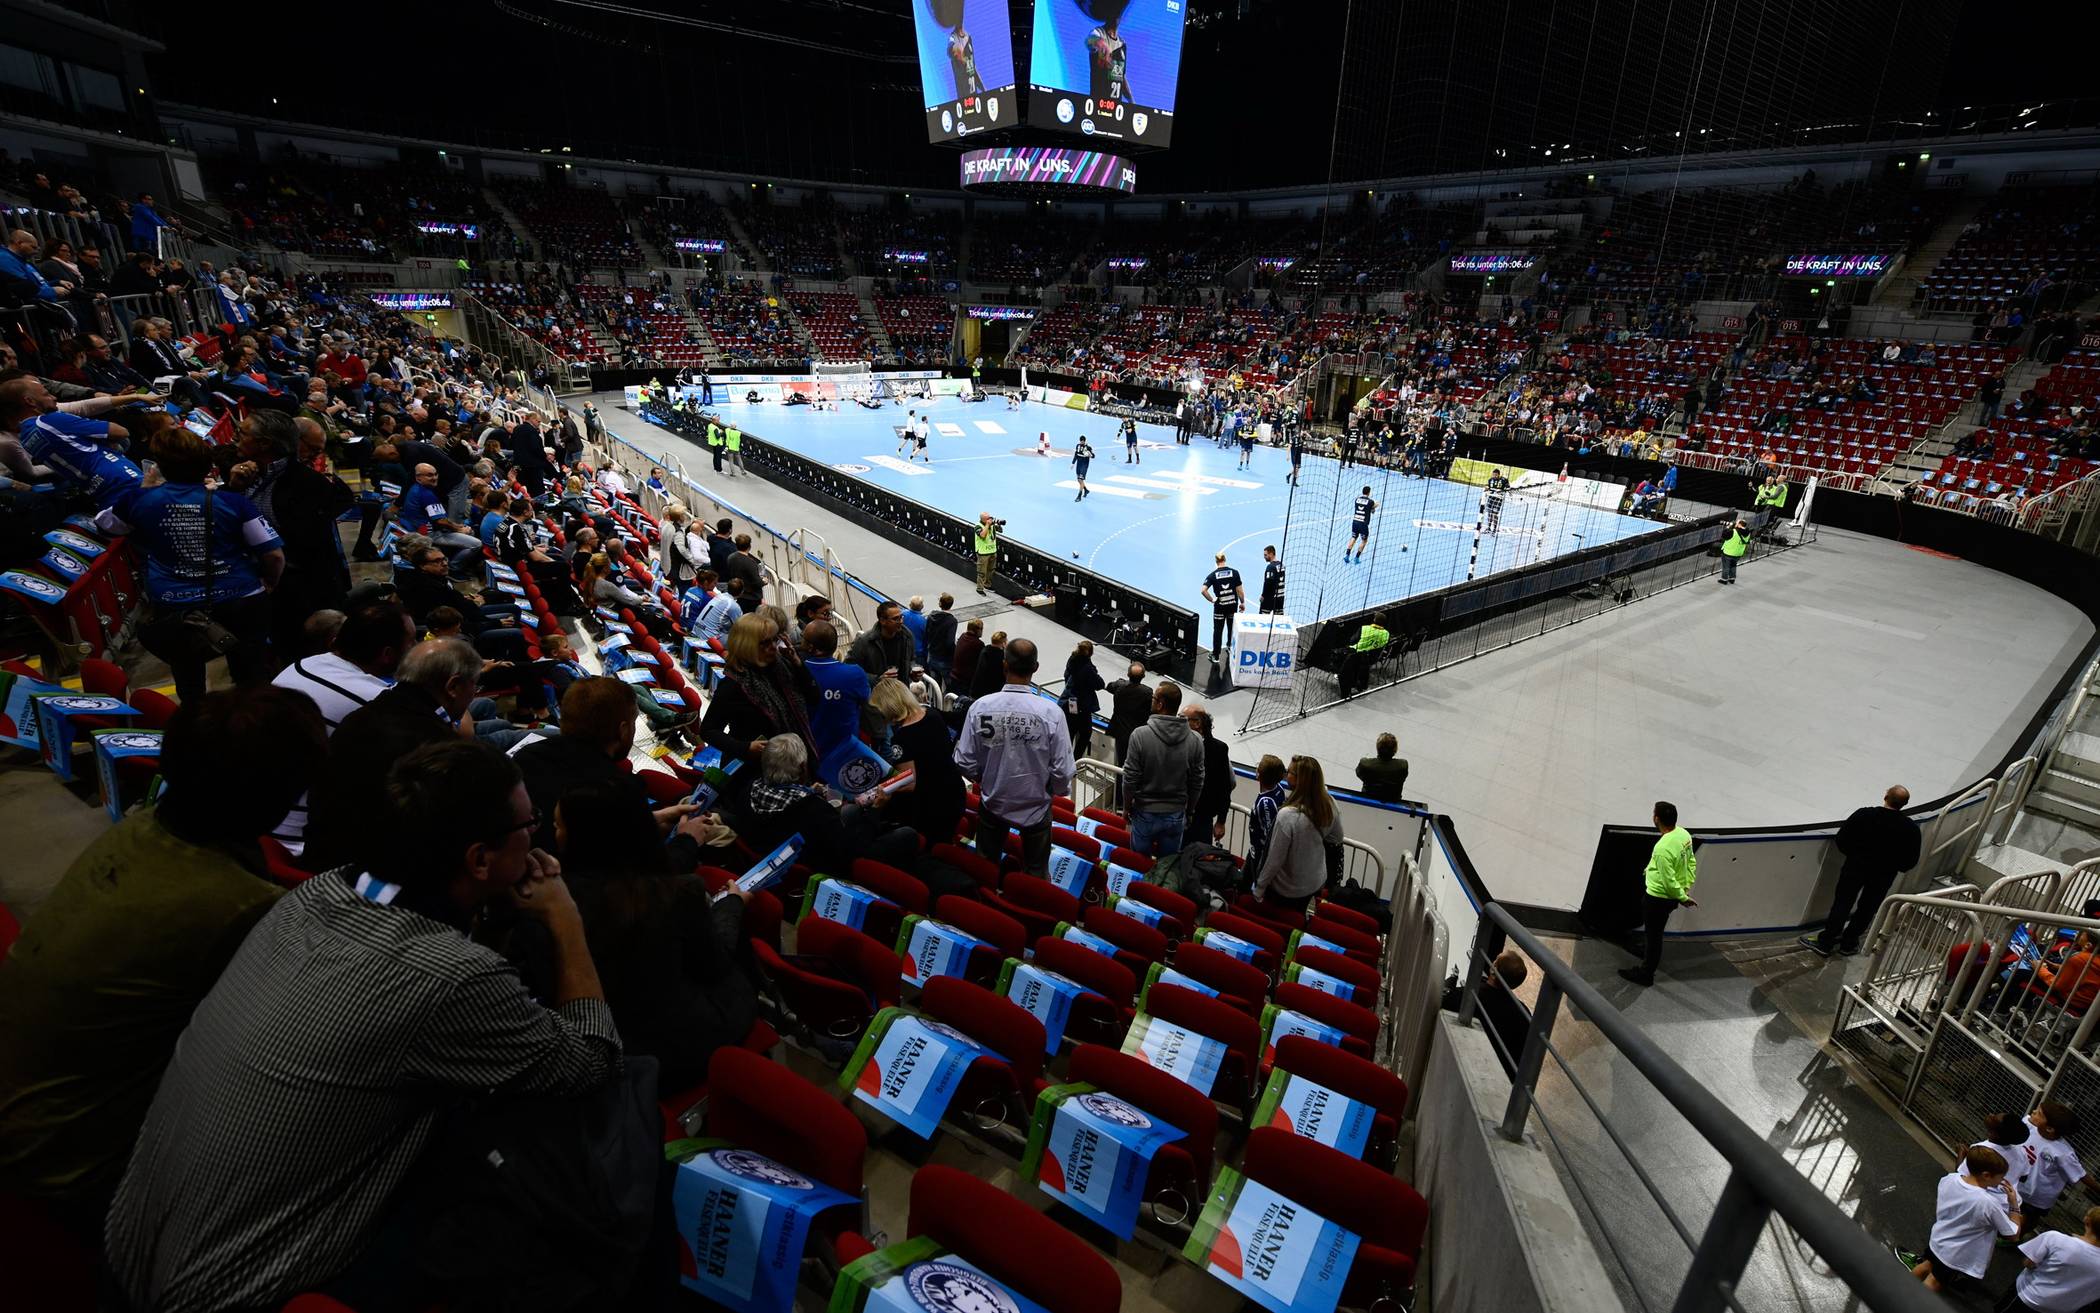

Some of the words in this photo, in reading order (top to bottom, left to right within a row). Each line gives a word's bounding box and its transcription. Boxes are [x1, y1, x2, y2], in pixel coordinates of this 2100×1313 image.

[1085, 99, 1094, 115] 0
[1100, 99, 1114, 109] 0:00
[1115, 104, 1124, 120] 0
[964, 161, 975, 174] DIE
[976, 158, 1013, 173] KRAFT
[1015, 158, 1029, 171] IN
[1040, 160, 1074, 174] UNS.
[1477, 261, 1496, 269] unter
[1786, 261, 1804, 270] DIE
[1805, 261, 1841, 270] KRAFT
[1842, 261, 1855, 270] IN
[1856, 261, 1883, 271] UNS.
[419, 298, 451, 307] bhc06.de
[1006, 311, 1034, 319] bhc06.de
[1724, 319, 1739, 328] 015
[1782, 321, 1798, 331] 015
[2081, 336, 2100, 347] 016
[1240, 650, 1291, 668] DKB
[824, 689, 841, 700] 06
[979, 715, 995, 738] 5
[829, 892, 842, 920] HAAN
[921, 935, 941, 978] HAANER
[1027, 980, 1042, 1012] HAAN
[882, 1036, 916, 1090] FELSENQUELLE
[886, 1037, 928, 1098] HAANER
[1066, 1128, 1085, 1185] FELSENQUELLE
[1073, 1128, 1099, 1194] HAANER
[707, 1188, 738, 1279] HAANER
[1245, 1202, 1280, 1269] FELSENQUELLE
[1252, 1203, 1297, 1281] HAANER
[1318, 1228, 1347, 1283] rstklassig.
